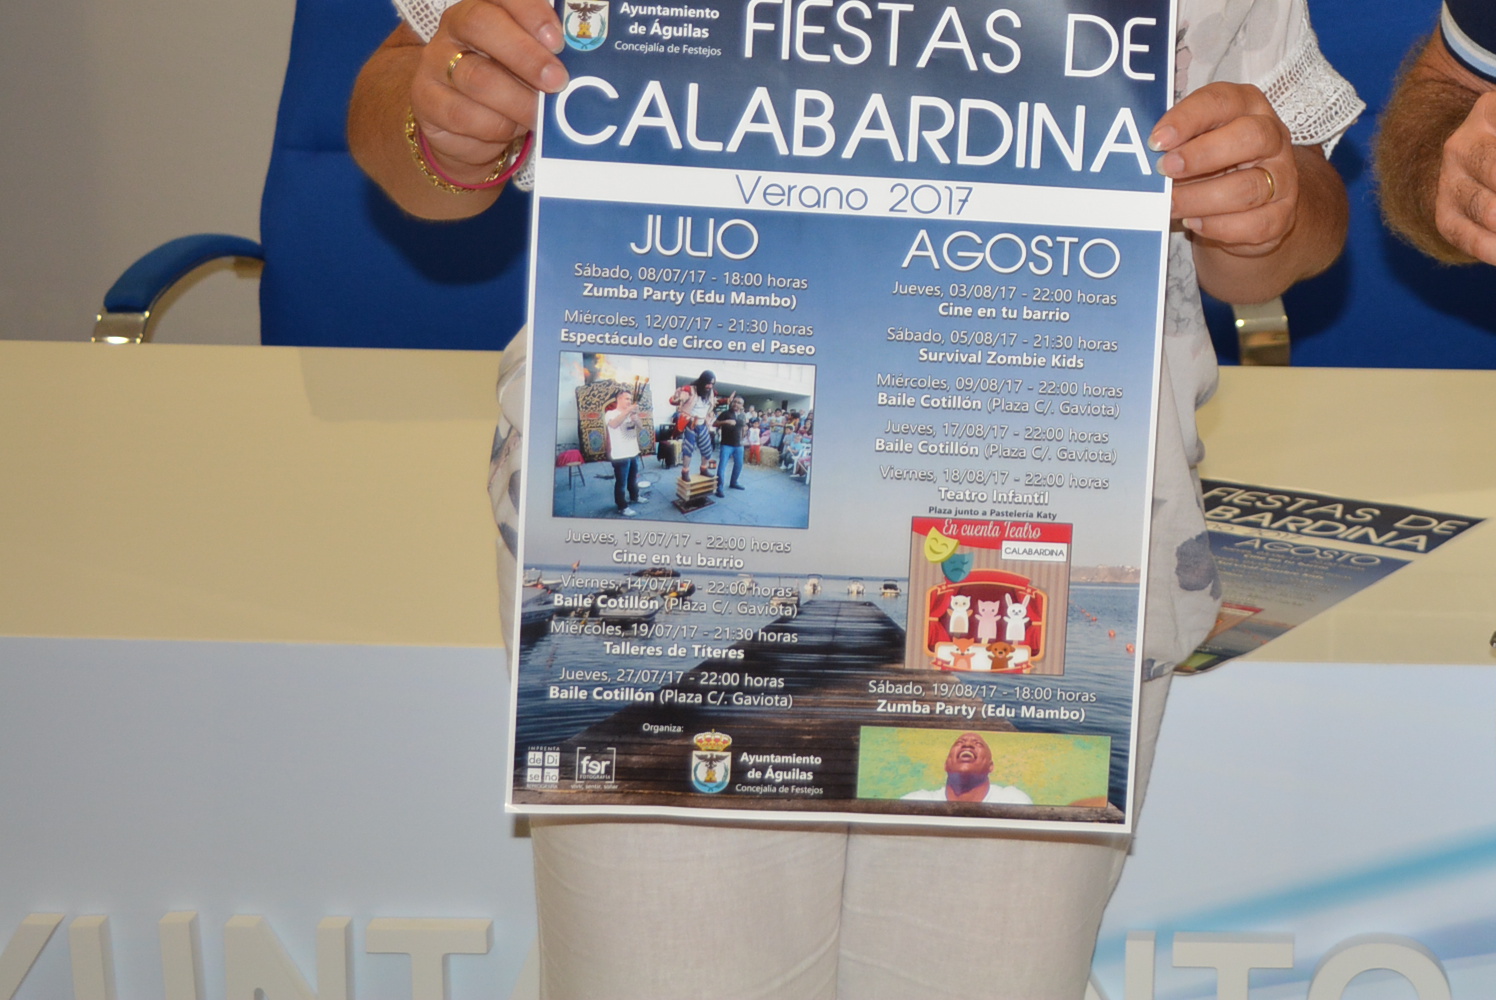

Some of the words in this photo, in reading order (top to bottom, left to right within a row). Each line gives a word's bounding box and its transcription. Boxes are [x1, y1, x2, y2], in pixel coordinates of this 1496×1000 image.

[619, 1, 719, 20] Ayuntamiento
[628, 21, 646, 34] de
[649, 19, 709, 39] Águilas
[614, 40, 664, 54] Concejalía
[682, 44, 721, 57] Festejos
[1064, 13, 1155, 80] DE
[555, 76, 1152, 176] CALABARDINA
[735, 174, 868, 210] Verano
[888, 183, 972, 215] 2017
[630, 214, 758, 259] JULIO
[902, 230, 1120, 277] AGOSTO
[574, 262, 632, 280] Sábado,
[638, 266, 705, 283] 08/07/17
[723, 271, 762, 286] 18:00
[767, 273, 807, 288] horas
[582, 282, 637, 298] Zumba
[643, 286, 684, 304] Party
[690, 289, 724, 304] (Edu
[730, 291, 796, 309] Mambo)
[892, 280, 943, 297] Jueves,
[949, 283, 1016, 299] 03/08/17
[1032, 287, 1072, 301] 22:00
[1077, 289, 1116, 304] horas
[564, 309, 638, 327] Miércoles,
[645, 314, 711, 329] 12/07/17
[728, 317, 767, 332] 21:30
[773, 320, 812, 335] horas
[938, 302, 972, 316] Cine
[1001, 306, 1017, 318] tu
[1022, 305, 1069, 320] barrio
[560, 328, 652, 345] Espectáculo
[658, 333, 677, 347] de
[682, 335, 722, 349] Circo
[751, 338, 764, 351] el
[770, 339, 814, 354] Paseo
[887, 326, 944, 343] Sábado,
[950, 329, 1016, 345] 05/08/17
[1033, 333, 1072, 348] 21:30
[1078, 335, 1117, 350] horas
[919, 347, 981, 362] Survival
[986, 350, 1045, 366] Zombie
[1051, 353, 1083, 367] Kids
[877, 373, 949, 389] Miércoles,
[955, 376, 1022, 391] 09/08/17
[1038, 380, 1077, 394] 22:00
[1083, 382, 1122, 396] horas
[878, 391, 915, 406] Baile
[920, 394, 981, 408] Cotillón
[987, 397, 1028, 411] (Plaza
[1034, 399, 1054, 414] C/.
[1059, 400, 1119, 415] Gaviota)
[875, 438, 912, 451] Baile
[918, 440, 978, 454] Cotillón
[984, 443, 1025, 456] (Plaza
[1032, 445, 1051, 459] C/.
[1057, 446, 1116, 460] Gaviota)
[939, 486, 986, 500] Teatro
[993, 489, 1048, 503] Infantil
[1202, 487, 1381, 521] FIESTAS
[1394, 514, 1471, 535] DE
[1204, 505, 1428, 551] BARDINA
[613, 549, 646, 563] Cine
[676, 554, 691, 565] tu
[697, 553, 744, 567] barrio
[1235, 538, 1381, 565] AGOSTO
[603, 641, 662, 655] Talleres
[667, 643, 686, 656] de
[692, 644, 744, 661] Títeres
[559, 667, 612, 682] Jueves,
[617, 668, 683, 683] 27/07/17
[700, 672, 738, 685] 22:00
[743, 675, 784, 688] horas
[549, 685, 587, 699] Baile
[592, 686, 654, 702] Cotillón
[659, 689, 702, 704] (Plaza
[707, 690, 726, 705] C/.
[732, 691, 792, 708] Gaviota)
[868, 679, 925, 695] Sábado,
[931, 682, 996, 701] 19/08/17
[1015, 686, 1051, 700] 18:00
[1057, 687, 1095, 702] horas
[876, 699, 930, 714] Zumba
[935, 701, 975, 719] Party
[981, 703, 1015, 718] (Edu
[1020, 705, 1084, 722] Mambo)
[642, 722, 683, 733] Organiza:
[739, 751, 822, 765] Ayuntamiento
[746, 767, 761, 779] de
[764, 766, 813, 782] Águilas
